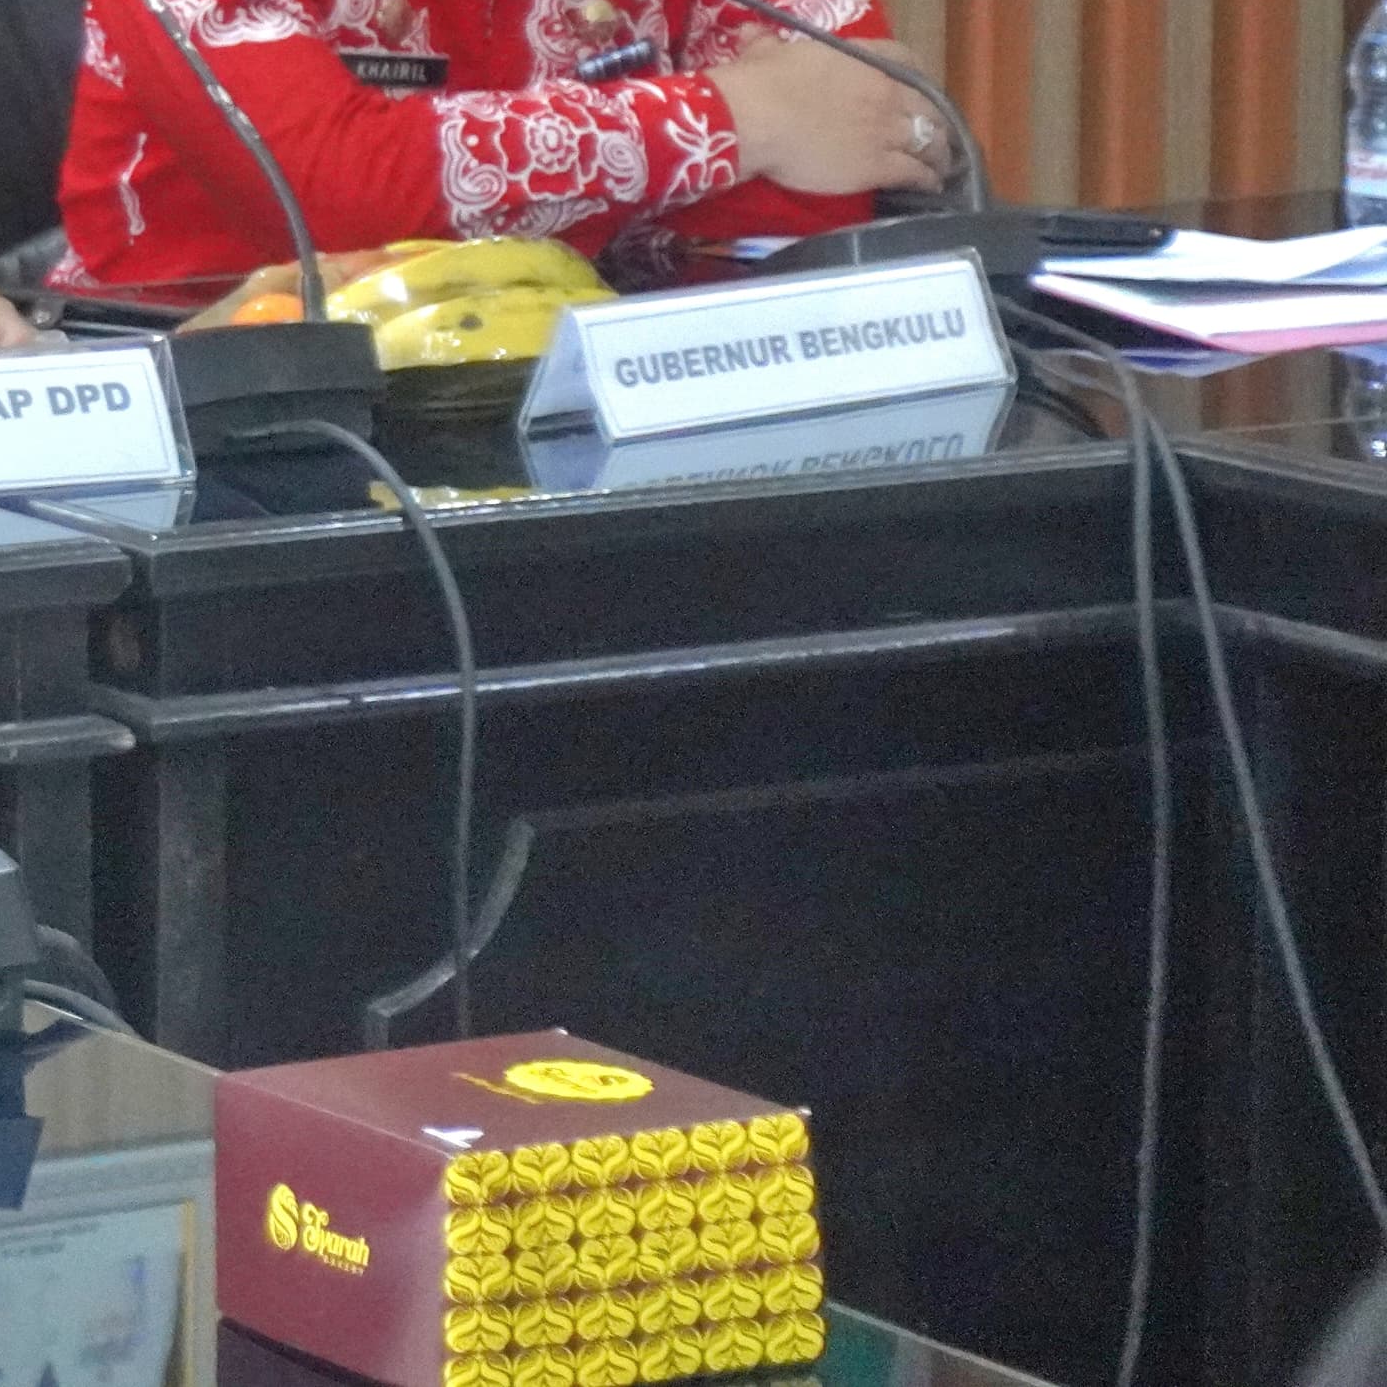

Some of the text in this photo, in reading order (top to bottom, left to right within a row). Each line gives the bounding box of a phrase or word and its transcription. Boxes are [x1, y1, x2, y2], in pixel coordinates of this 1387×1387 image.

[614, 307, 965, 388] GUBERNUR BENGKULU
[45, 381, 132, 417] DPD
